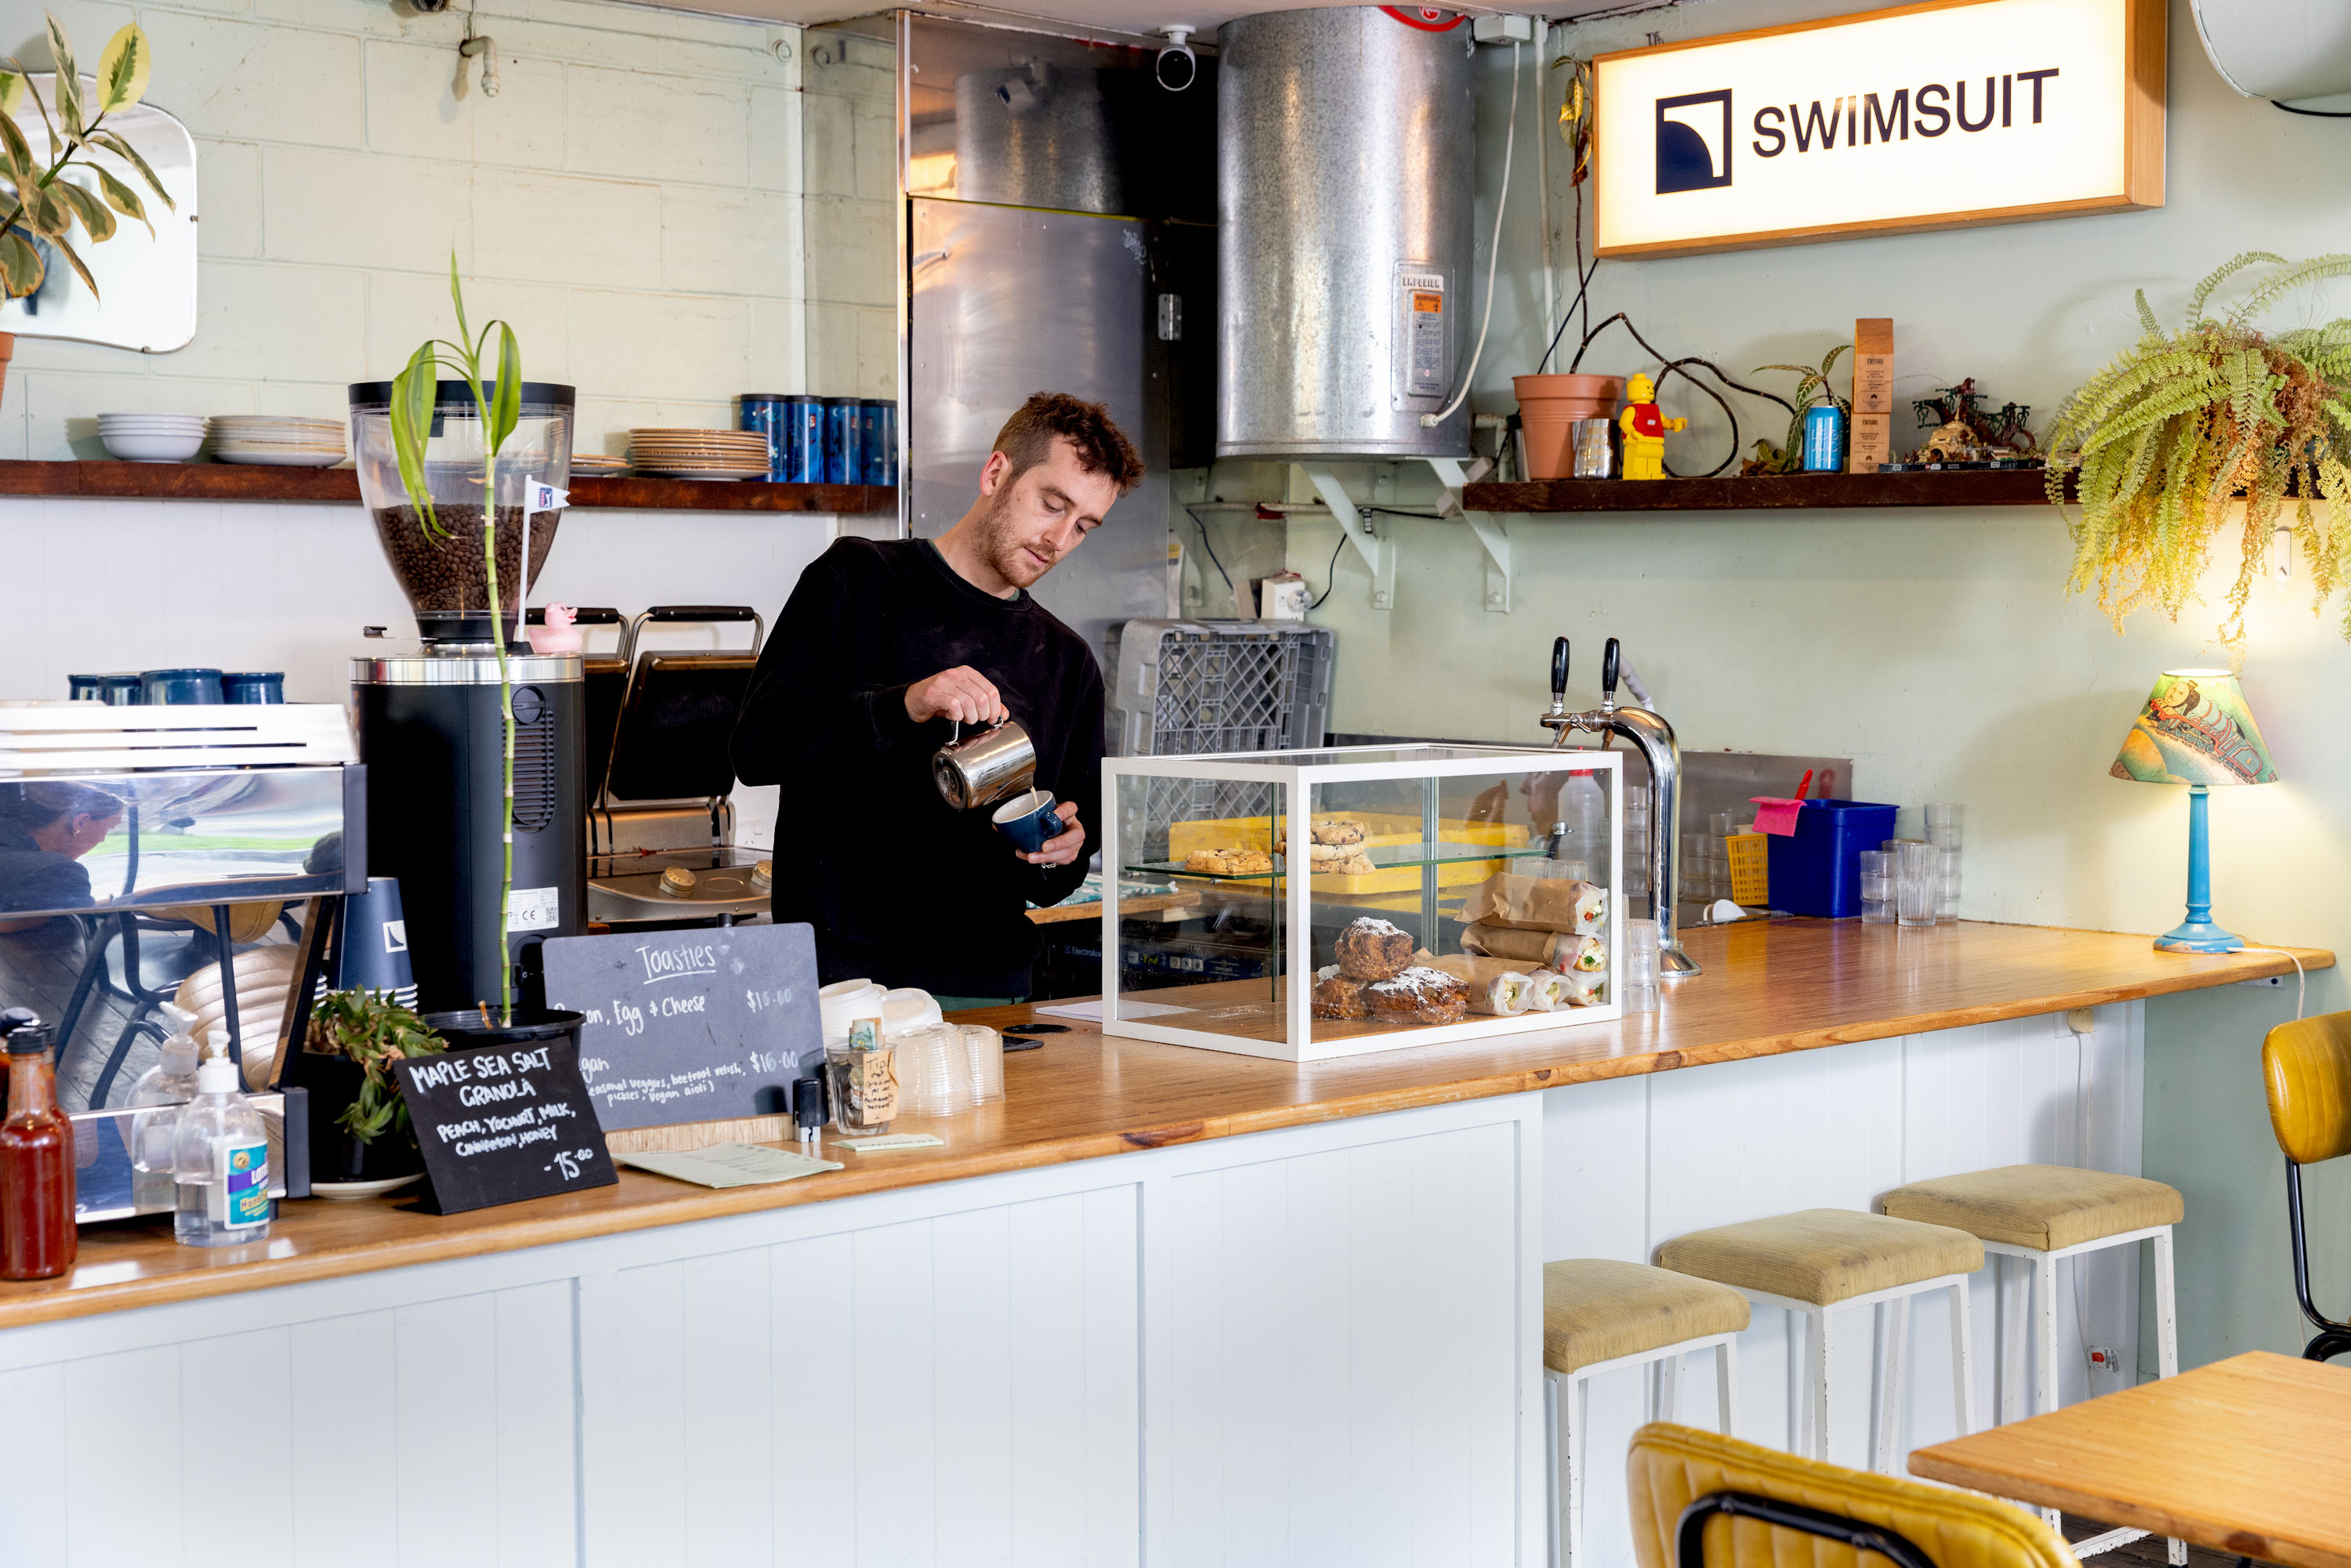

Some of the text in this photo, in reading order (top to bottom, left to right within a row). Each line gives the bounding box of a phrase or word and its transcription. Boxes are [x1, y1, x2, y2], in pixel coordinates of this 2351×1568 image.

[1752, 67, 2059, 158] SWIMSUIT
[636, 944, 716, 980] Toasties
[613, 999, 644, 1036] Egg
[661, 994, 705, 1017] Cheese
[408, 1047, 552, 1094] MAPLE SEA SALT
[579, 1057, 610, 1084] gan
[671, 1067, 712, 1085] beetroot
[459, 1078, 537, 1107] GRANOLA
